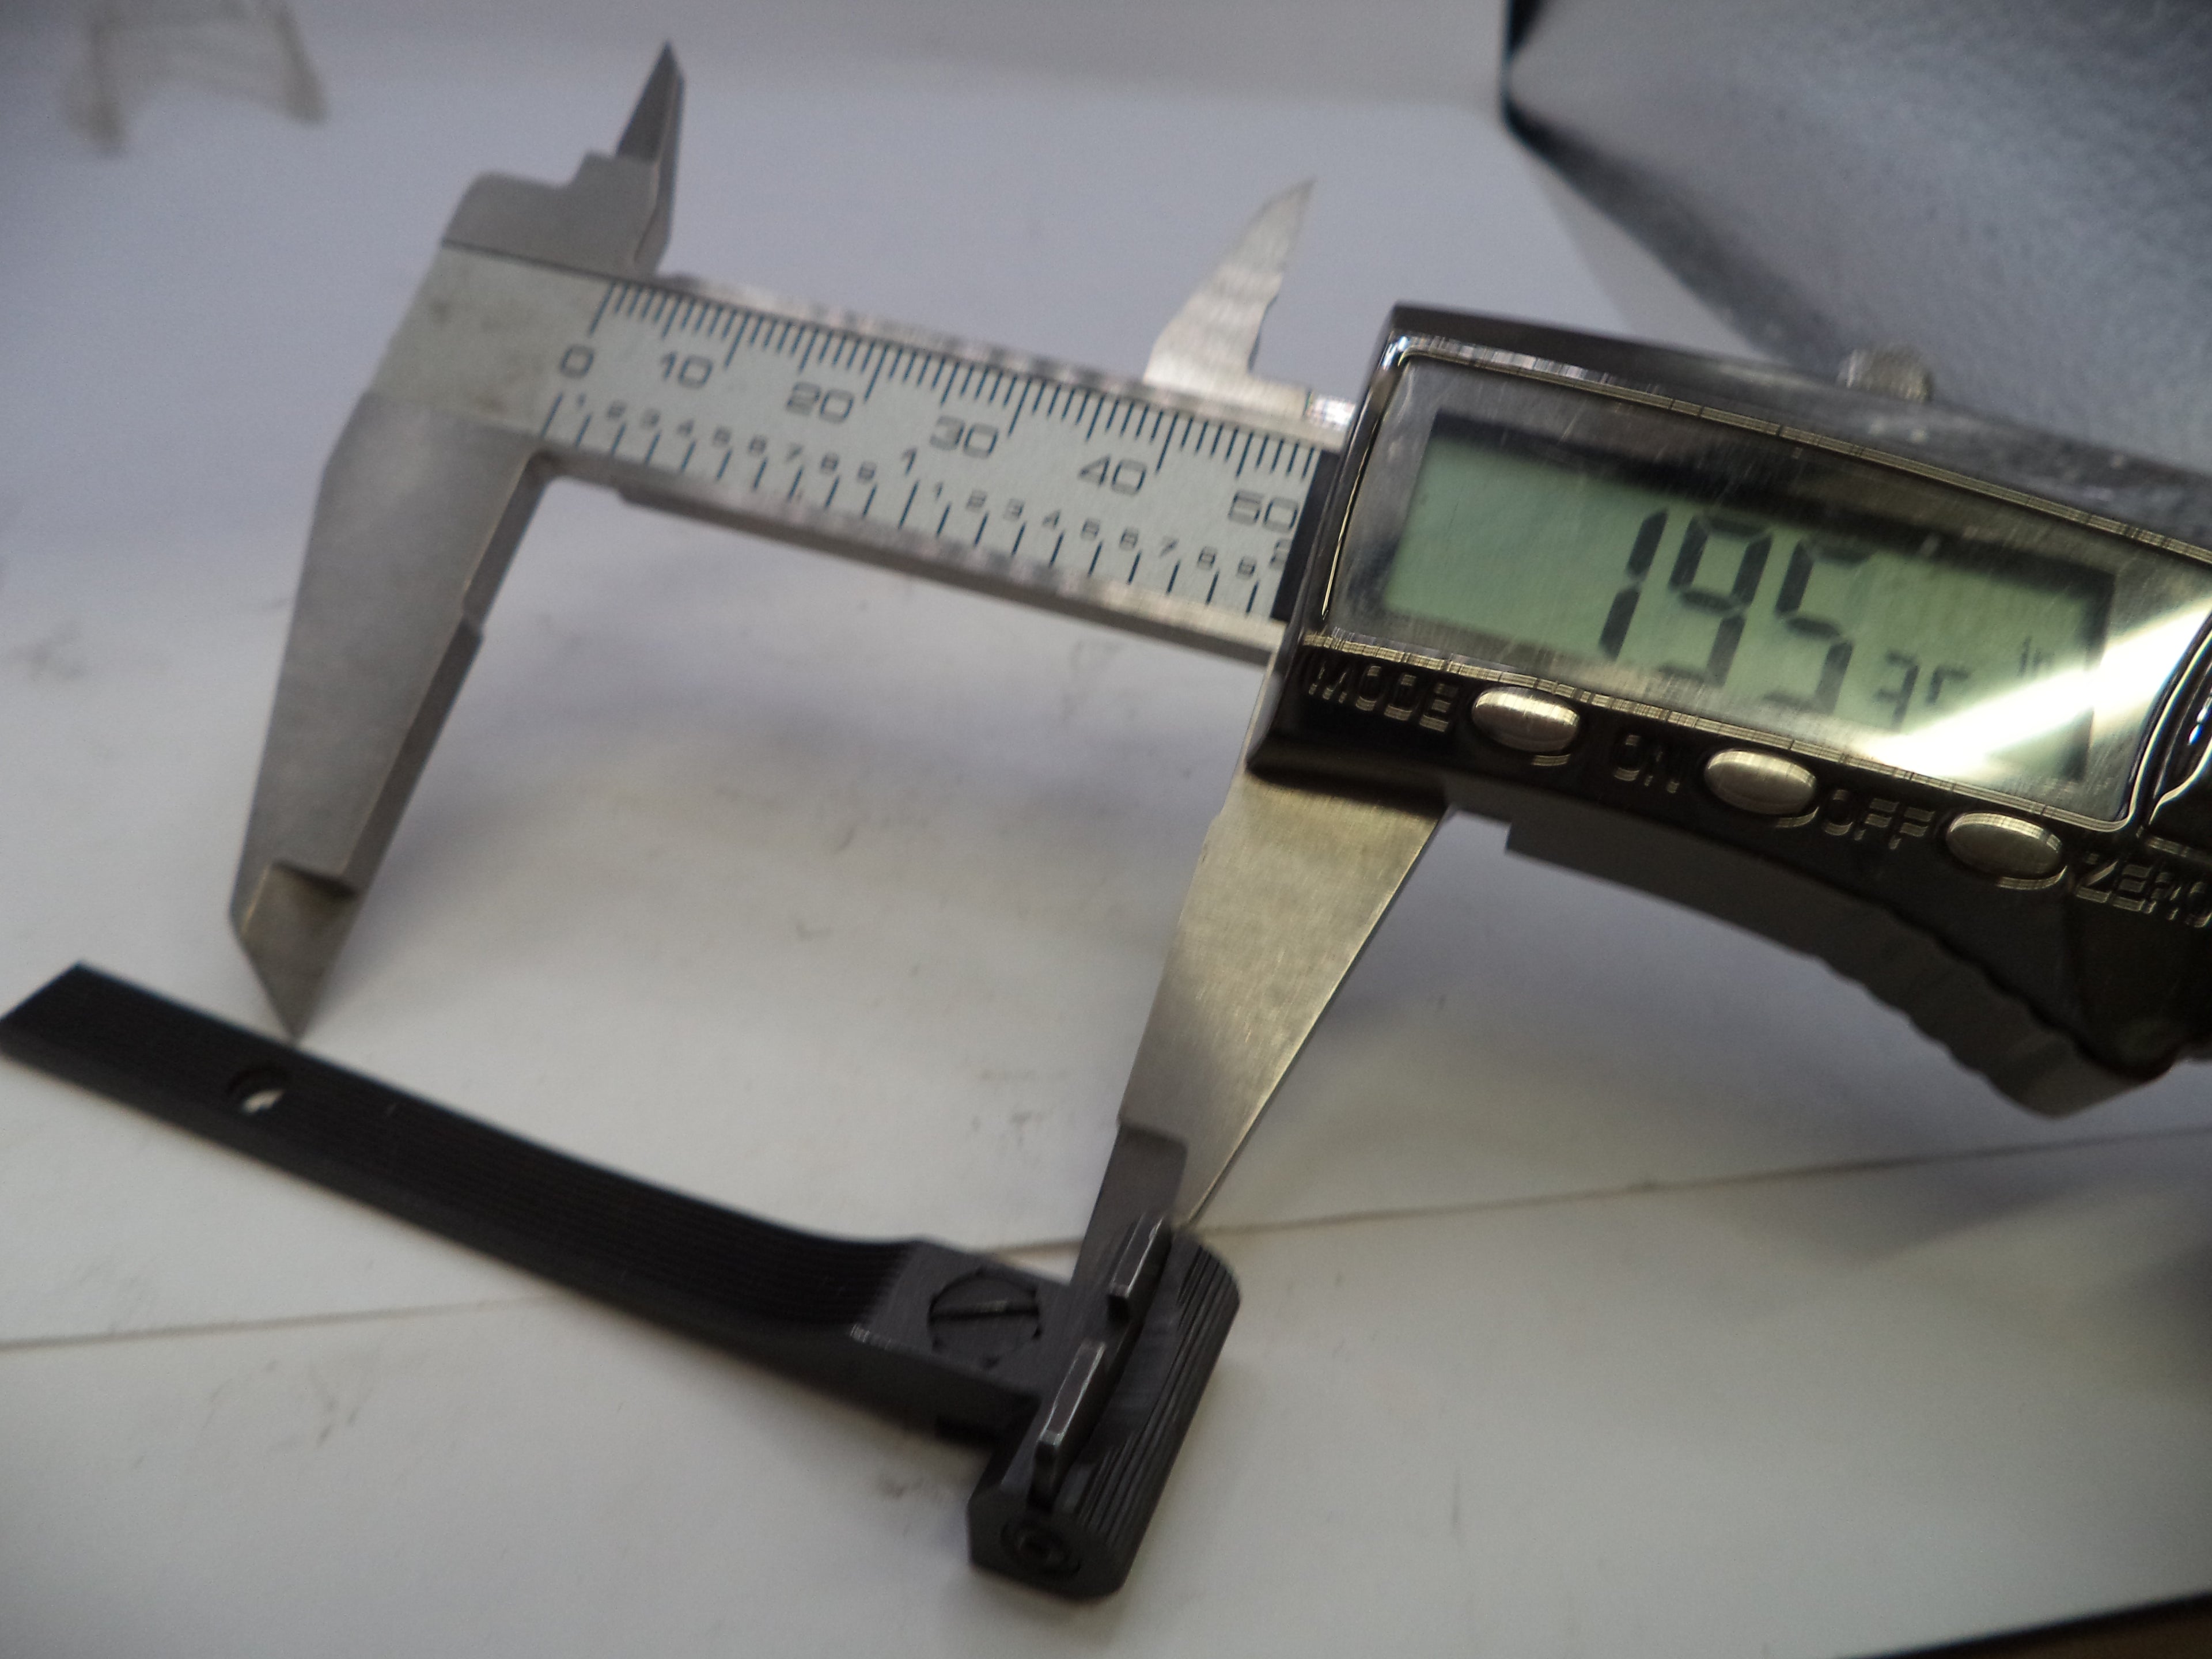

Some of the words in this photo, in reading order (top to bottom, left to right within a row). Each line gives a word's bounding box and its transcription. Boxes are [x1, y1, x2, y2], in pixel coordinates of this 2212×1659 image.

[560, 344, 594, 378] 0
[661, 351, 714, 389] 10
[786, 381, 855, 424] 20
[930, 415, 998, 460] 30
[1078, 455, 1147, 496] 40
[1228, 490, 1298, 534] 50
[902, 447, 918, 476] 1
[933, 482, 945, 503] 1
[1003, 498, 1024, 521] 3
[1042, 509, 1060, 529] 4
[1159, 537, 1179, 558] 7
[1309, 665, 1457, 733] MODE
[1613, 734, 1688, 794] ON
[1823, 789, 1937, 850] OFF
